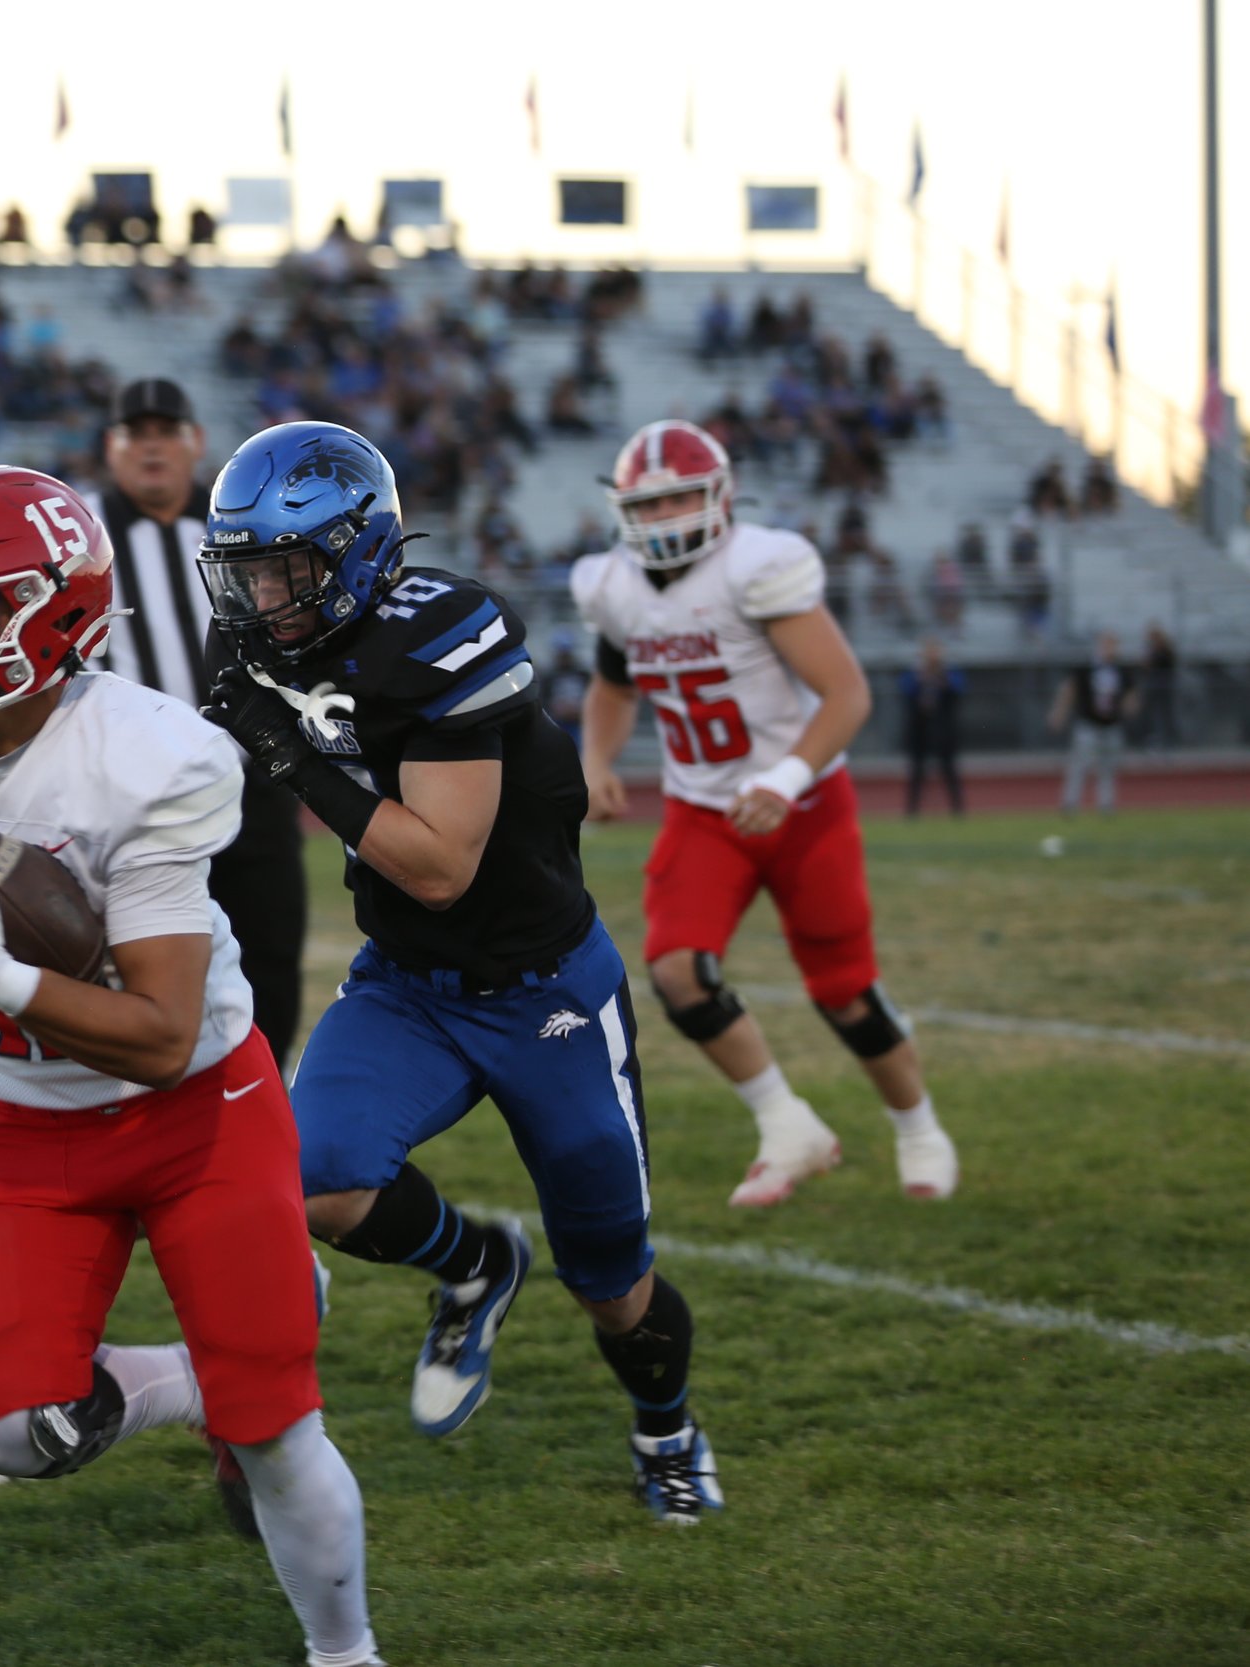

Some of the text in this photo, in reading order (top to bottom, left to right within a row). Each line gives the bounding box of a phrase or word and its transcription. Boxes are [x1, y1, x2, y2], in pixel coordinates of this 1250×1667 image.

[25, 497, 88, 563] 15
[214, 531, 250, 544] Riddell
[375, 576, 453, 620] 10
[634, 667, 752, 765] 56
